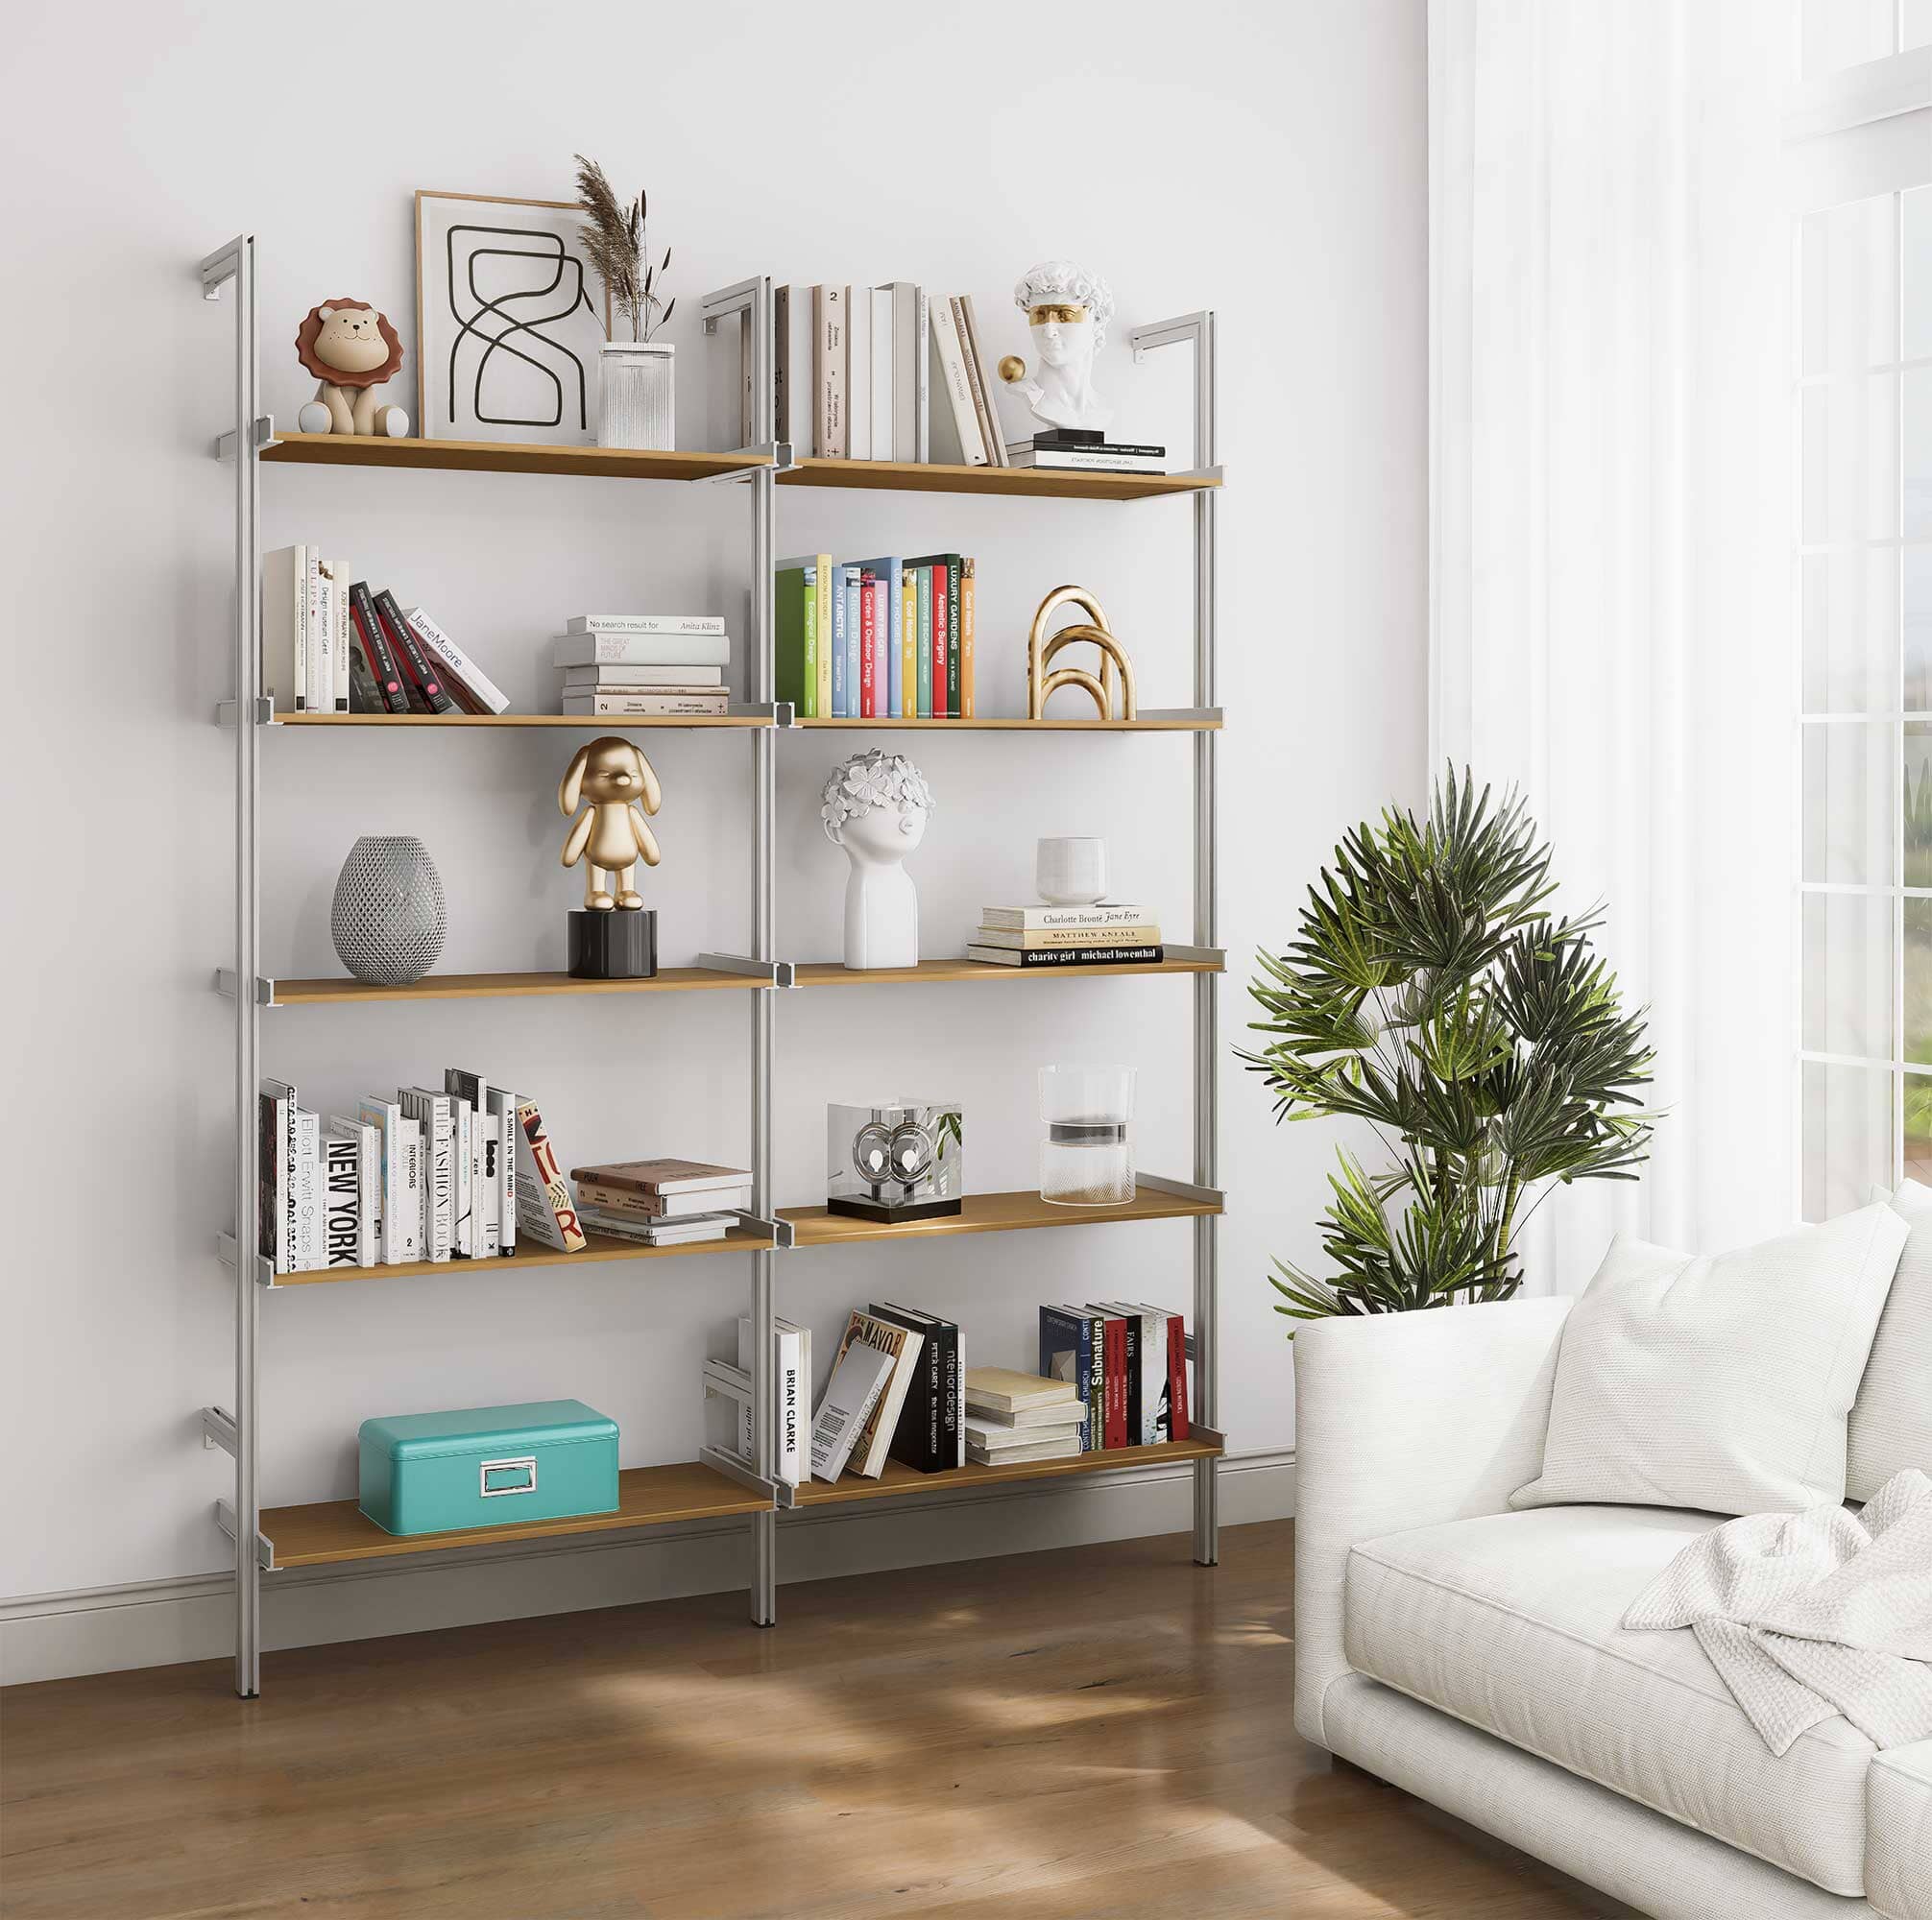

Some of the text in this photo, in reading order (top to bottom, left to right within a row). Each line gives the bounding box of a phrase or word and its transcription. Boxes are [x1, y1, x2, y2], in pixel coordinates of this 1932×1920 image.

[830, 292, 837, 301] 2
[589, 620, 600, 629] No
[626, 620, 646, 629] result
[679, 622, 720, 632] Anita Klinz
[850, 632, 858, 662] Design
[936, 630, 945, 664] Surgery
[863, 662, 872, 687] Design
[1043, 914, 1077, 924] Charlotte
[1103, 911, 1123, 924] Jane
[1123, 910, 1140, 922] Eyre
[1027, 948, 1156, 963] charity girl michael lowenthal
[507, 1145, 514, 1155] IN
[300, 1118, 314, 1253] Elliott Erwitt Snaps
[435, 1099, 448, 1260] THE FASHION BOOK
[328, 1142, 357, 1265] NEW YORK
[406, 1237, 413, 1248] 2
[1092, 1320, 1104, 1386] Subnature
[786, 1369, 795, 1453] BRIAN CLARKE
[945, 1391, 957, 1431] design
